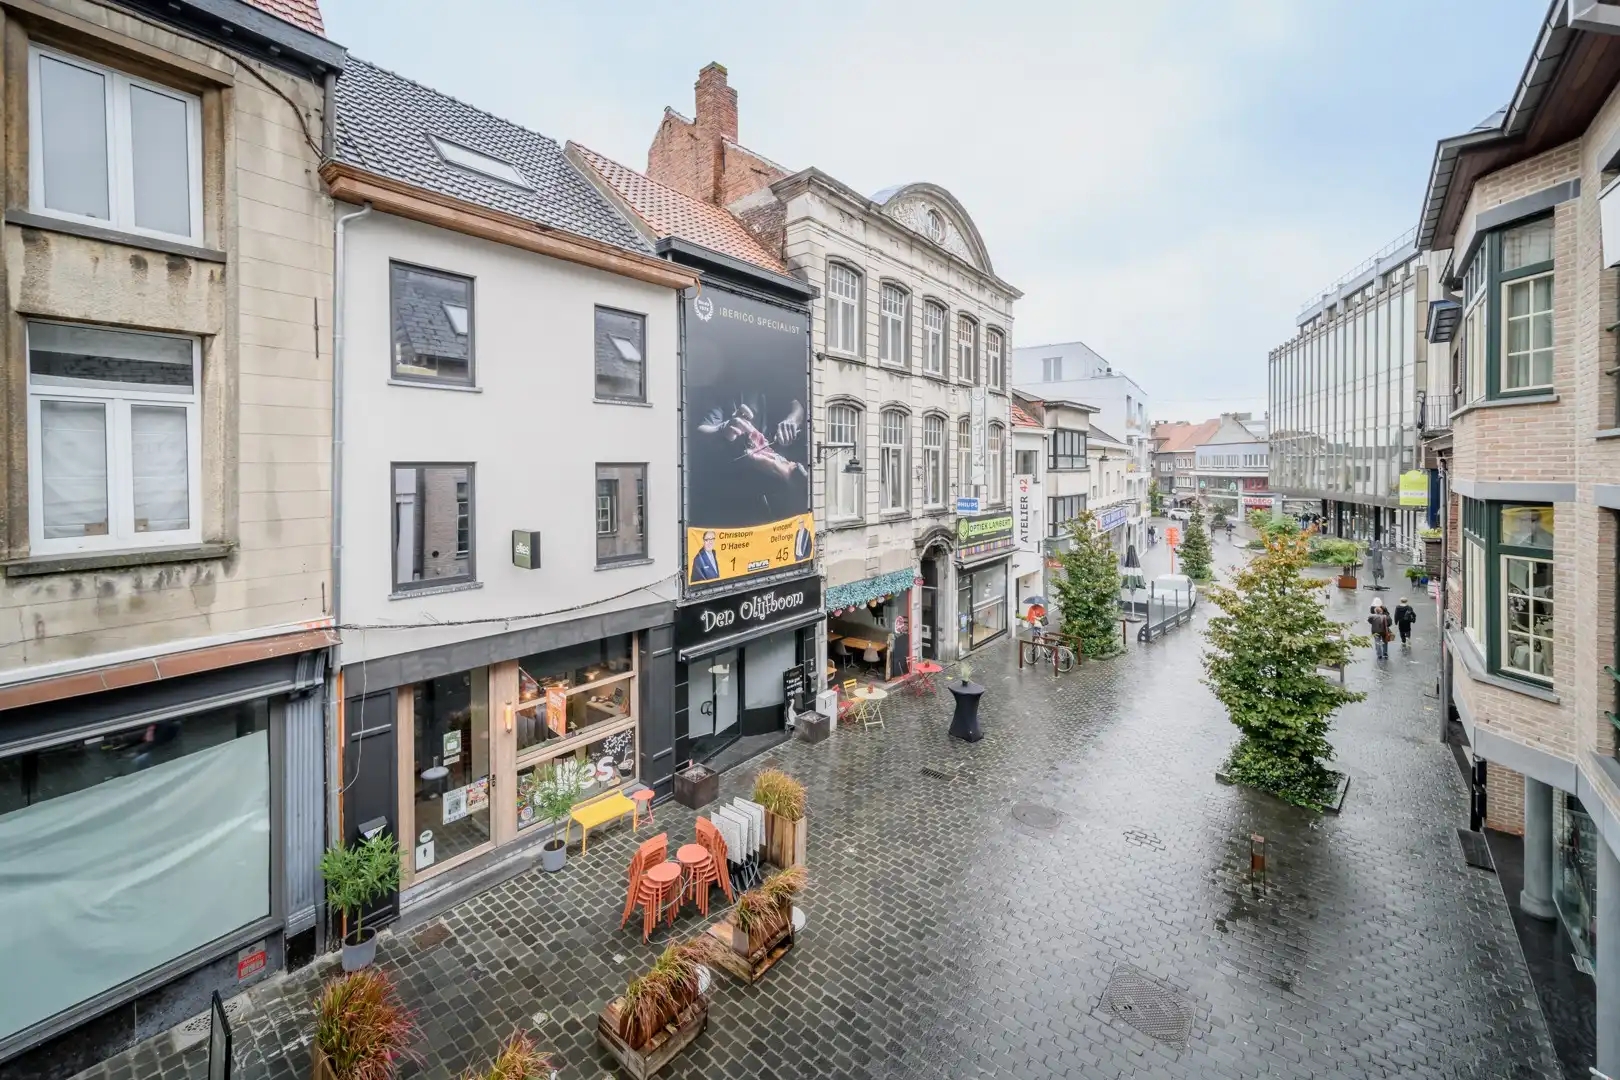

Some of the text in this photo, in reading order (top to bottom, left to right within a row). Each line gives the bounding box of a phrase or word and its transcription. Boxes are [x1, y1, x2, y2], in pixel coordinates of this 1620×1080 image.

[757, 316, 800, 335] SPECIALIST
[1019, 478, 1029, 543] ATELIER 42
[969, 518, 1011, 533] OPTIEK LAMBERT
[718, 530, 754, 540] Christoph
[720, 542, 750, 551] D'Haese
[775, 547, 789, 562] 45
[730, 556, 736, 572] 1
[700, 591, 804, 633] Den Olijfboom
